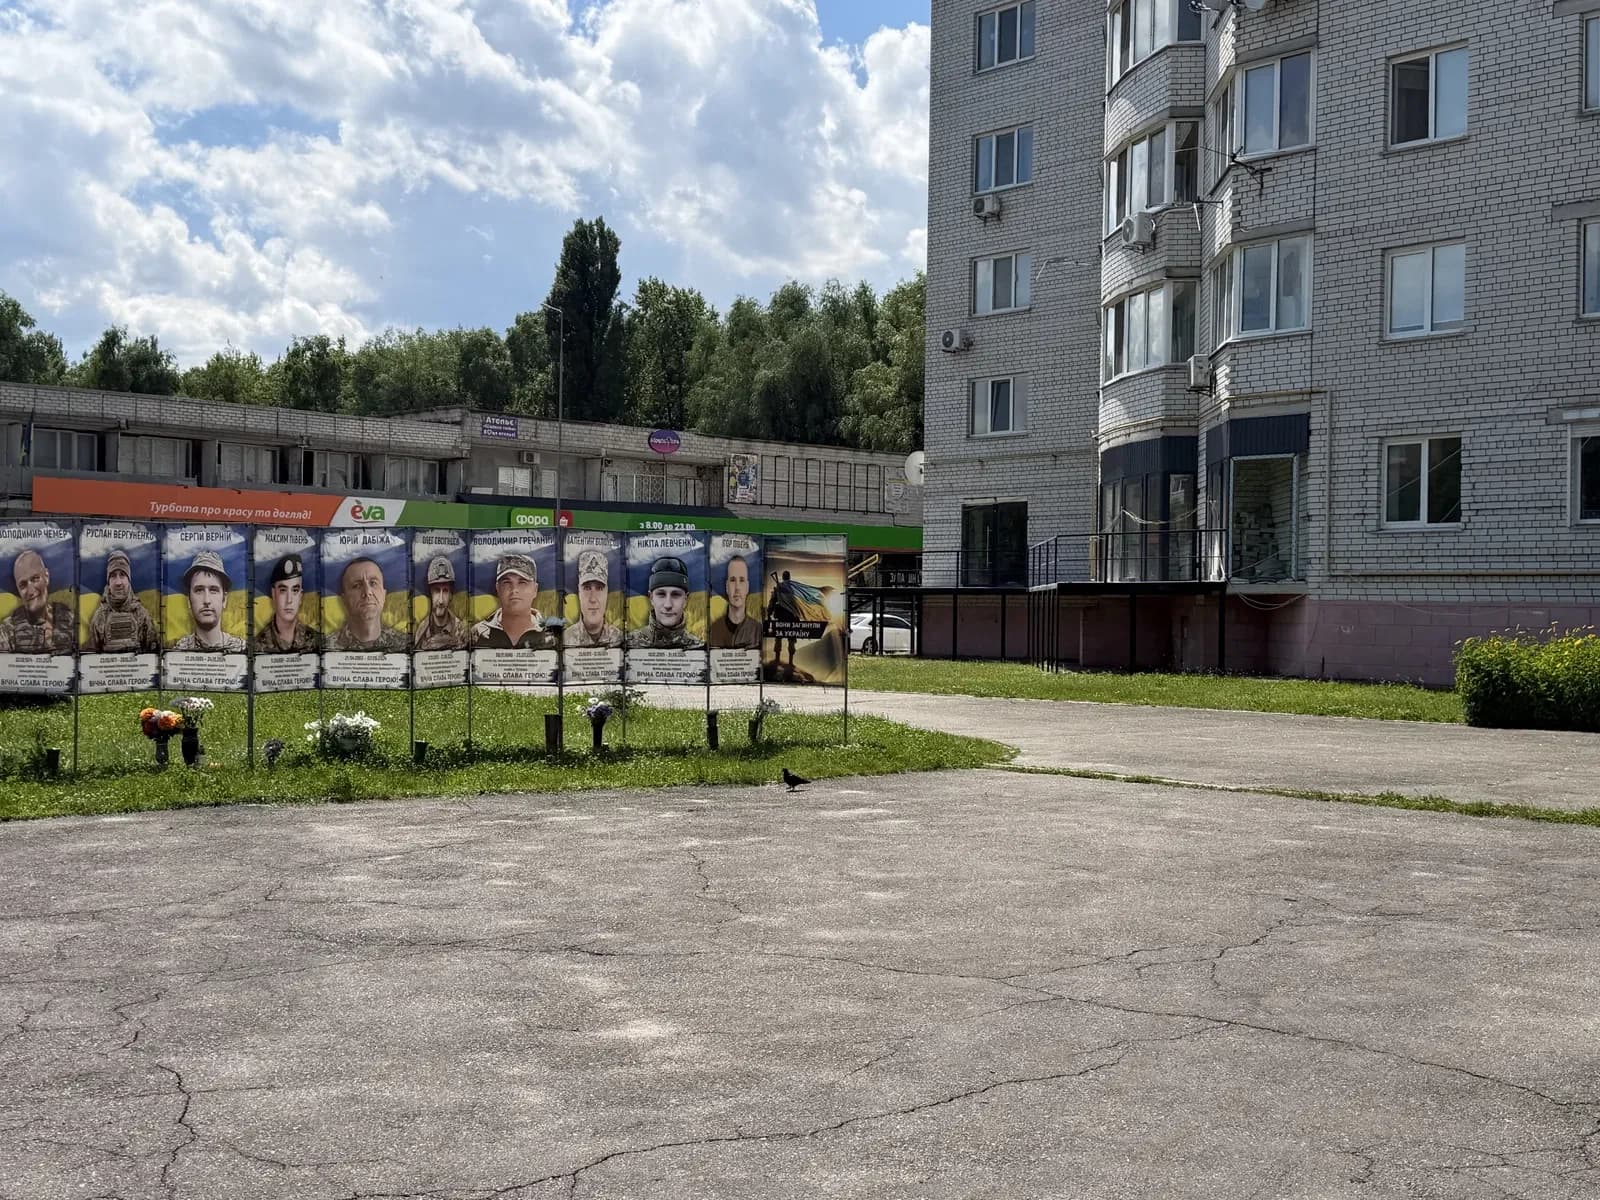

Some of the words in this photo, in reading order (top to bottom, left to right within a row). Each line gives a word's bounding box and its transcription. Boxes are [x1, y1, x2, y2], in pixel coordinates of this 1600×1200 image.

[150, 501, 199, 515] Турбота
[200, 506, 221, 516] про
[223, 507, 253, 519] красу
[255, 510, 271, 518] та
[273, 509, 312, 520] догляд!
[86, 528, 112, 538] РУСЛАН
[339, 534, 359, 544] ЮРІЙ
[362, 534, 391, 545] ДАБІЖА
[473, 536, 518, 546] ВОЛОДИМИР
[660, 537, 697, 548] ЛЕВЧЕНКО
[785, 629, 810, 637] УКРАЇНУ
